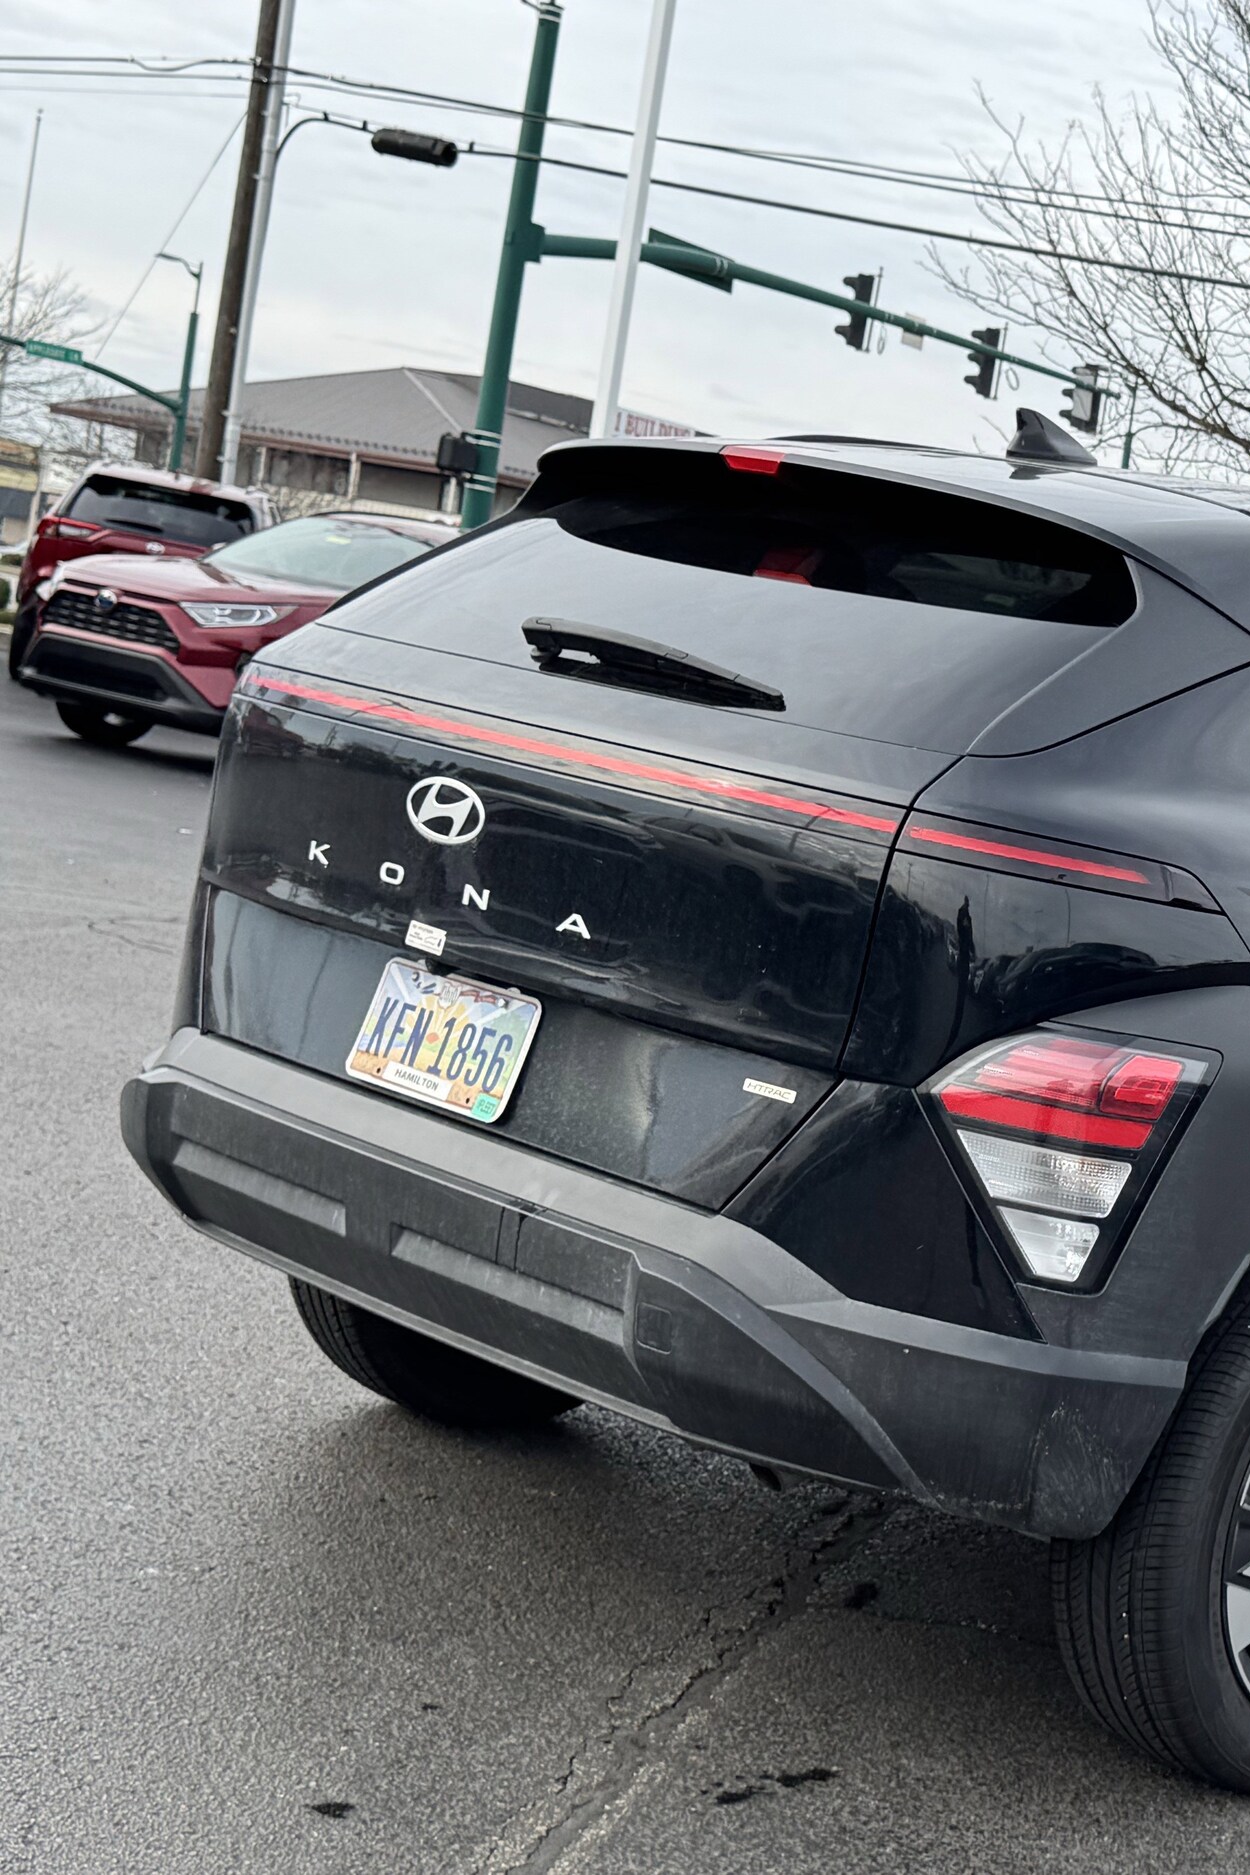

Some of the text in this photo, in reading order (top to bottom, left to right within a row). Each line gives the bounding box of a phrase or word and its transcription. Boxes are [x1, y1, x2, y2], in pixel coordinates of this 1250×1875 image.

[308, 840, 591, 939] KONA
[366, 996, 513, 1093] KFN 1856
[394, 1068, 440, 1092] HAMILTON
